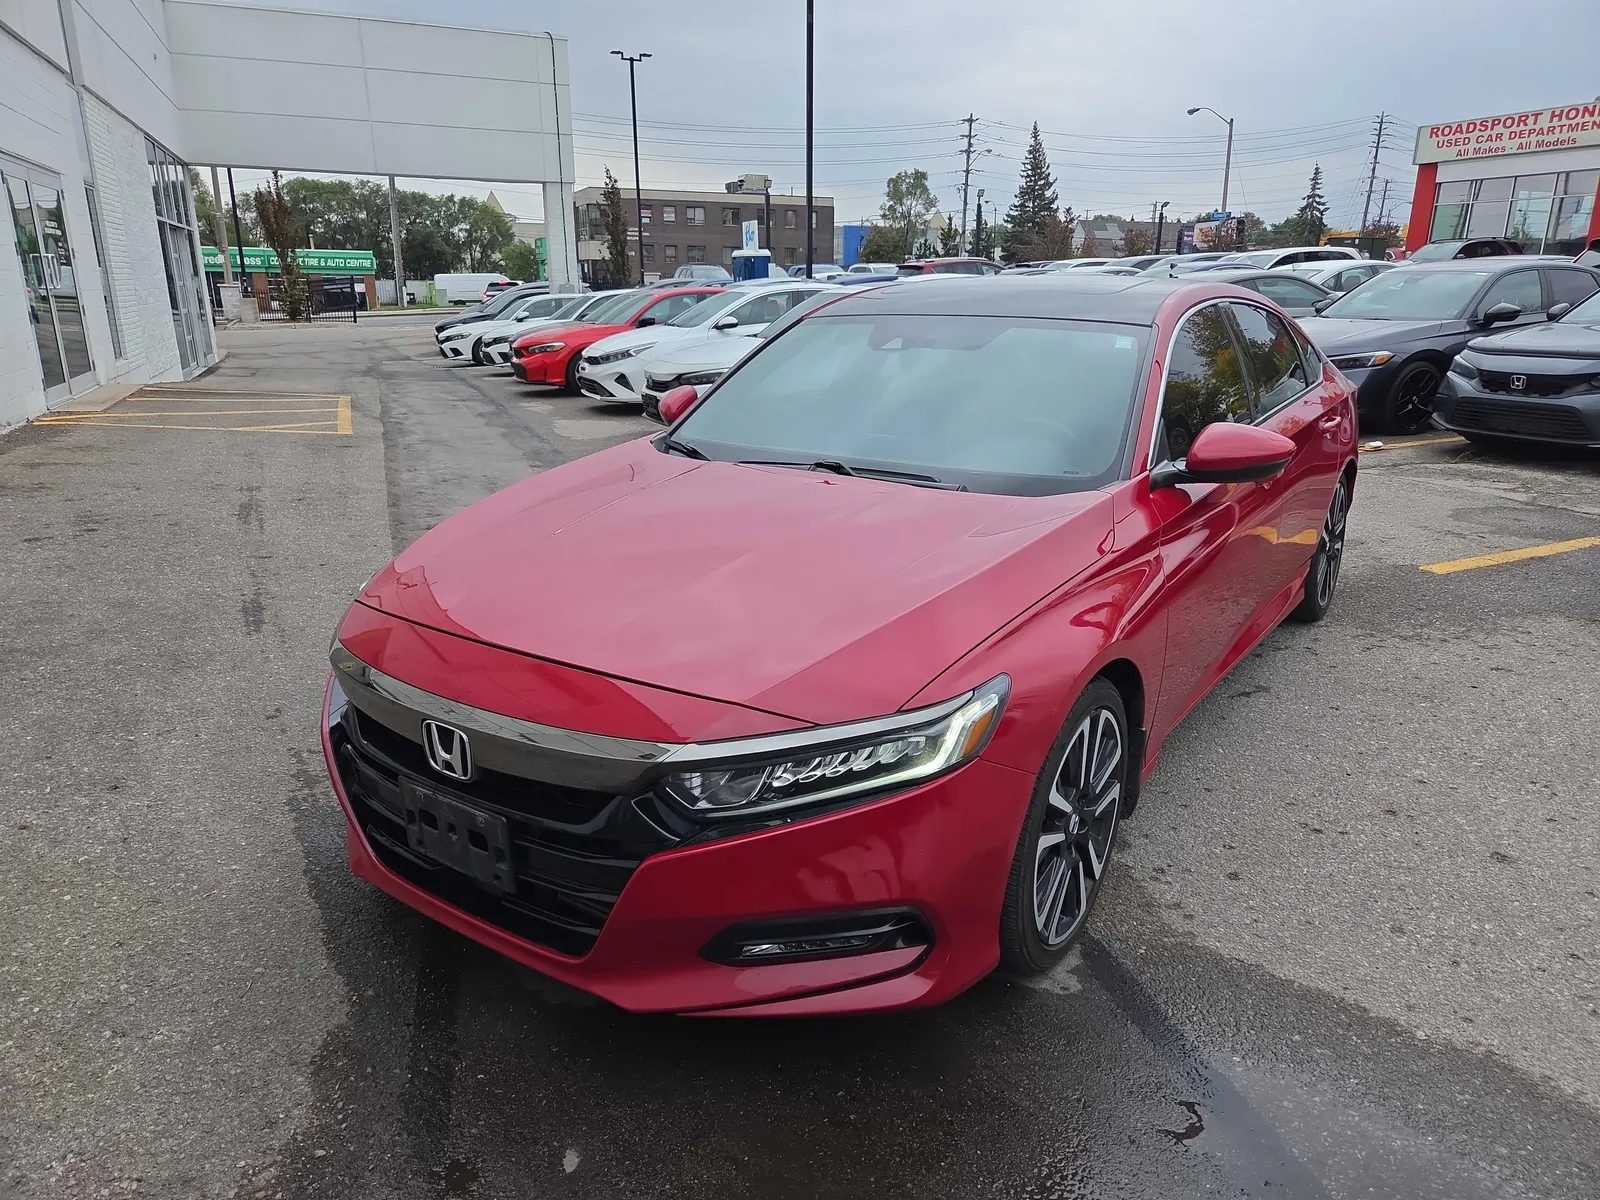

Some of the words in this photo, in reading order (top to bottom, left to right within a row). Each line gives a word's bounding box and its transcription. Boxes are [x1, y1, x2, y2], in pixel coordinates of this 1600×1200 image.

[1429, 112, 1543, 139] ROADSPORT
[1550, 104, 1600, 124] HON
[1436, 137, 1471, 149] USED
[1475, 132, 1504, 144] CAR
[1455, 148, 1469, 158] All
[1472, 144, 1506, 157] Makes
[1516, 141, 1531, 151] All
[1535, 136, 1577, 149] Models
[304, 258, 319, 266] TIRE
[327, 258, 345, 267] AUTO
[346, 259, 372, 268] CENTRE
